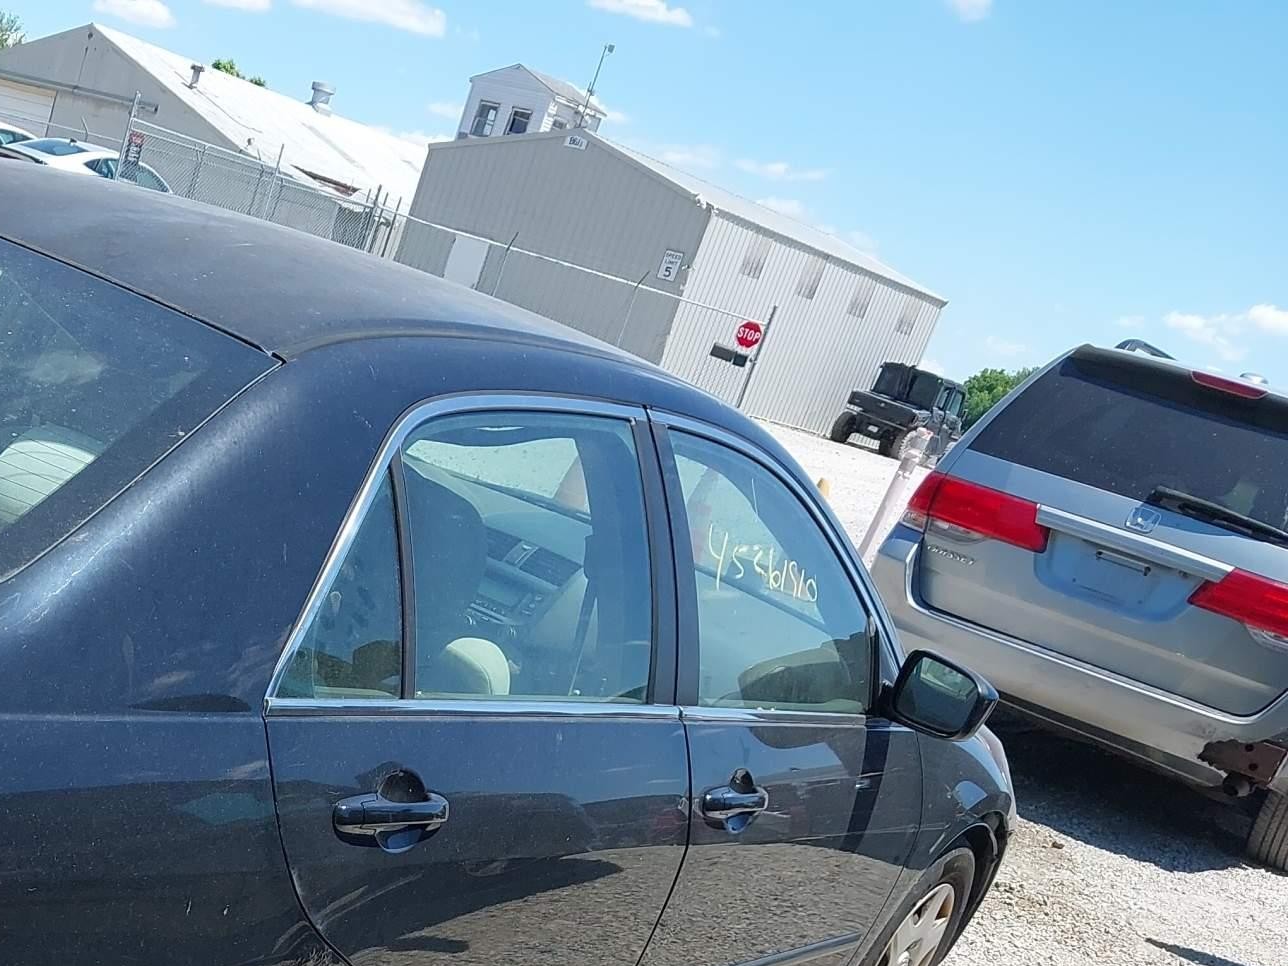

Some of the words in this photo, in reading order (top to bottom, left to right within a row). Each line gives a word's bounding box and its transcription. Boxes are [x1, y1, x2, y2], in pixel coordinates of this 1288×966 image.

[665, 252, 681, 260] SPEED
[663, 266, 672, 278] 5
[737, 327, 762, 342] STOP
[708, 522, 818, 602] 45261910
